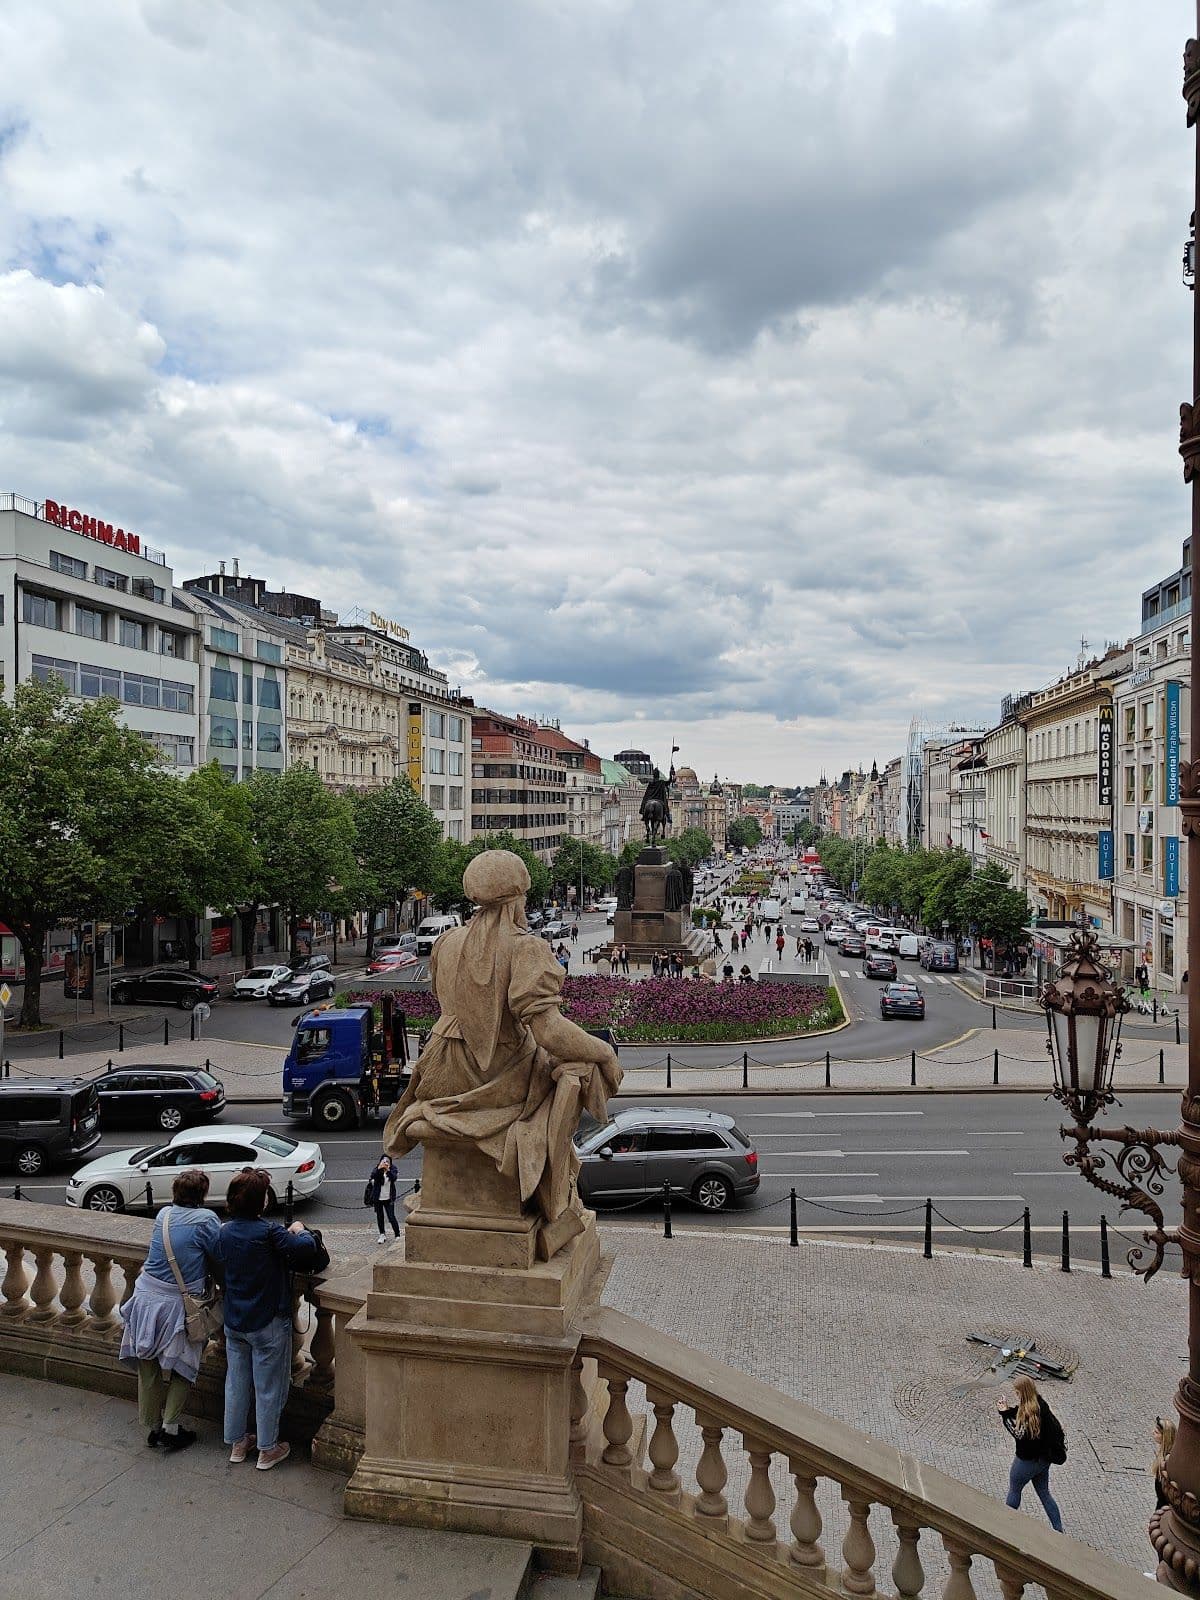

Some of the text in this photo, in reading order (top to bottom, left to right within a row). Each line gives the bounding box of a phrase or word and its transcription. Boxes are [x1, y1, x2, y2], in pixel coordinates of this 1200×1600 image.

[46, 499, 140, 555] RICHMAN
[1169, 700, 1177, 728] Wilson
[1169, 728, 1177, 754] Praha
